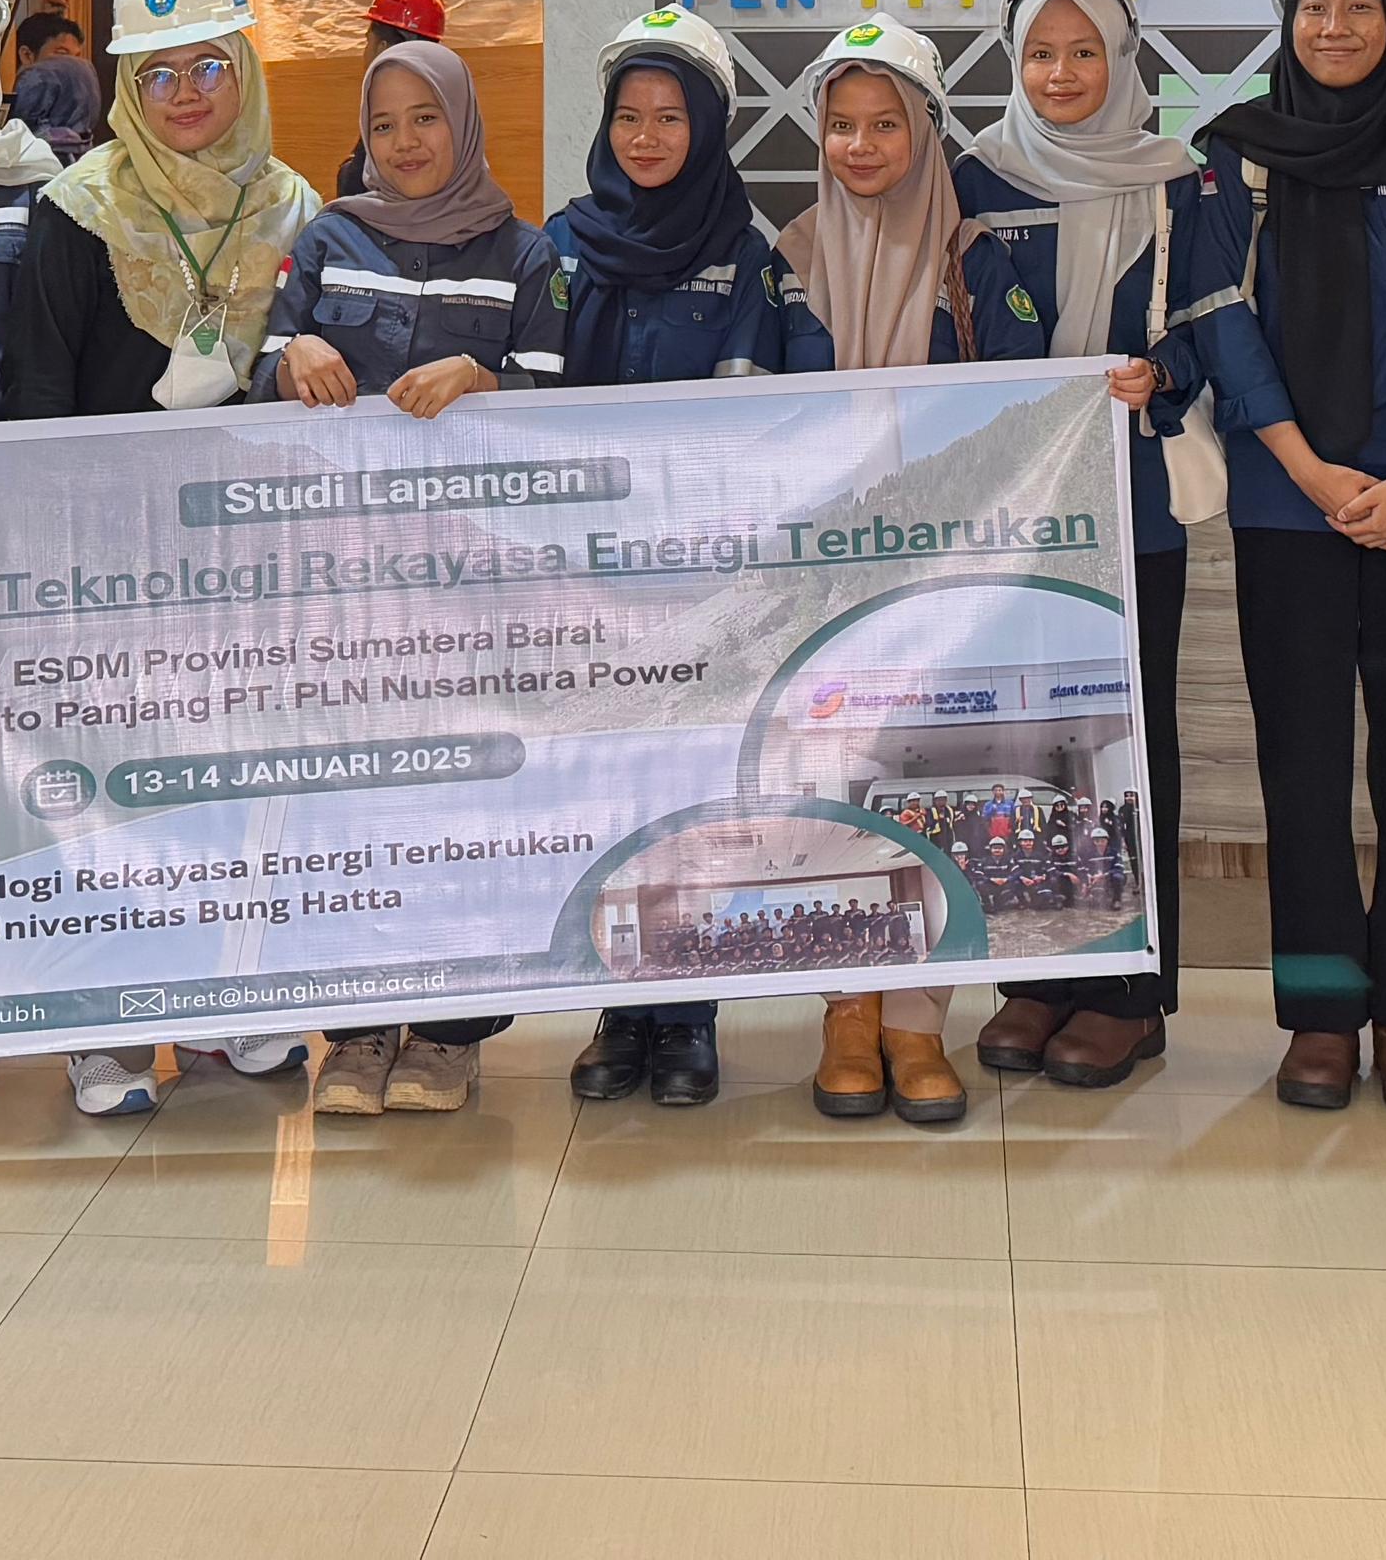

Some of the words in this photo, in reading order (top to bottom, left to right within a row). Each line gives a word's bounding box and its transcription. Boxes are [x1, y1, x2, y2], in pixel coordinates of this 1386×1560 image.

[224, 476, 345, 515] Studi
[361, 464, 586, 510] Lapangan
[300, 543, 568, 591] Rekayasa
[586, 523, 760, 573] Energi
[777, 506, 1097, 560] Terbarukan
[13, 651, 131, 687] ESDM
[144, 639, 297, 678] Provinsi
[309, 626, 494, 664] Sumatera
[506, 618, 606, 650] Barat
[54, 694, 211, 730] Panjang
[223, 685, 283, 715] PT.
[295, 677, 368, 709] PLN
[381, 665, 576, 703] Nusantara
[588, 659, 710, 689] Power
[124, 764, 220, 796] 13-14
[230, 751, 381, 787] JANUARI
[391, 745, 473, 775] 2025
[76, 855, 249, 893] Rekayasa
[262, 843, 373, 877] Energi
[384, 830, 593, 867] Terbarukan
[198, 895, 291, 926] Bung
[302, 885, 403, 916] Hatta
[172, 971, 446, 1010] tret@bunghatta.ac.id
